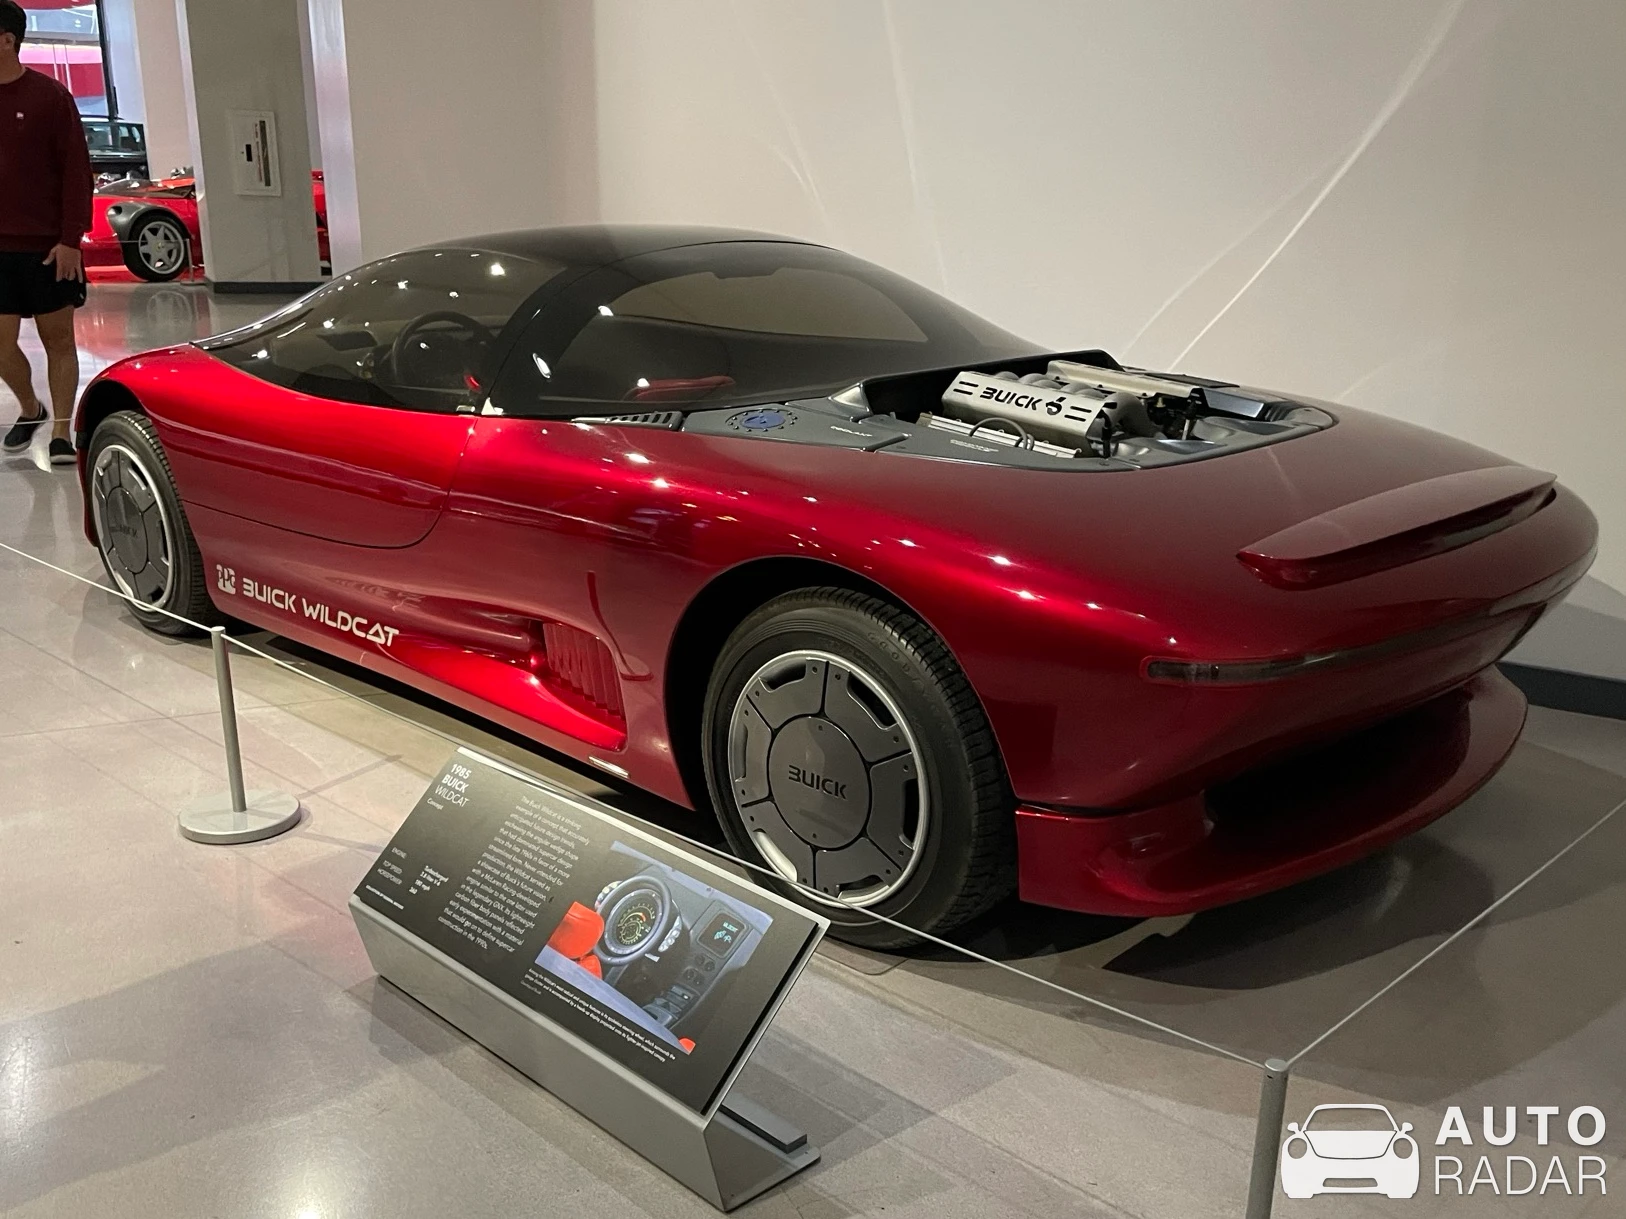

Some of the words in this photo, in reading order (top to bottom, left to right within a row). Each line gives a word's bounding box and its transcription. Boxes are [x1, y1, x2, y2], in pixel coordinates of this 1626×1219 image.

[980, 387, 1043, 410] BUICK
[242, 578, 296, 613] BUICK
[302, 598, 400, 647] WILDCAT
[451, 763, 471, 779] 1985
[441, 774, 469, 793] BUICK
[788, 765, 847, 800] BUICK
[435, 785, 469, 807] WILDCAT
